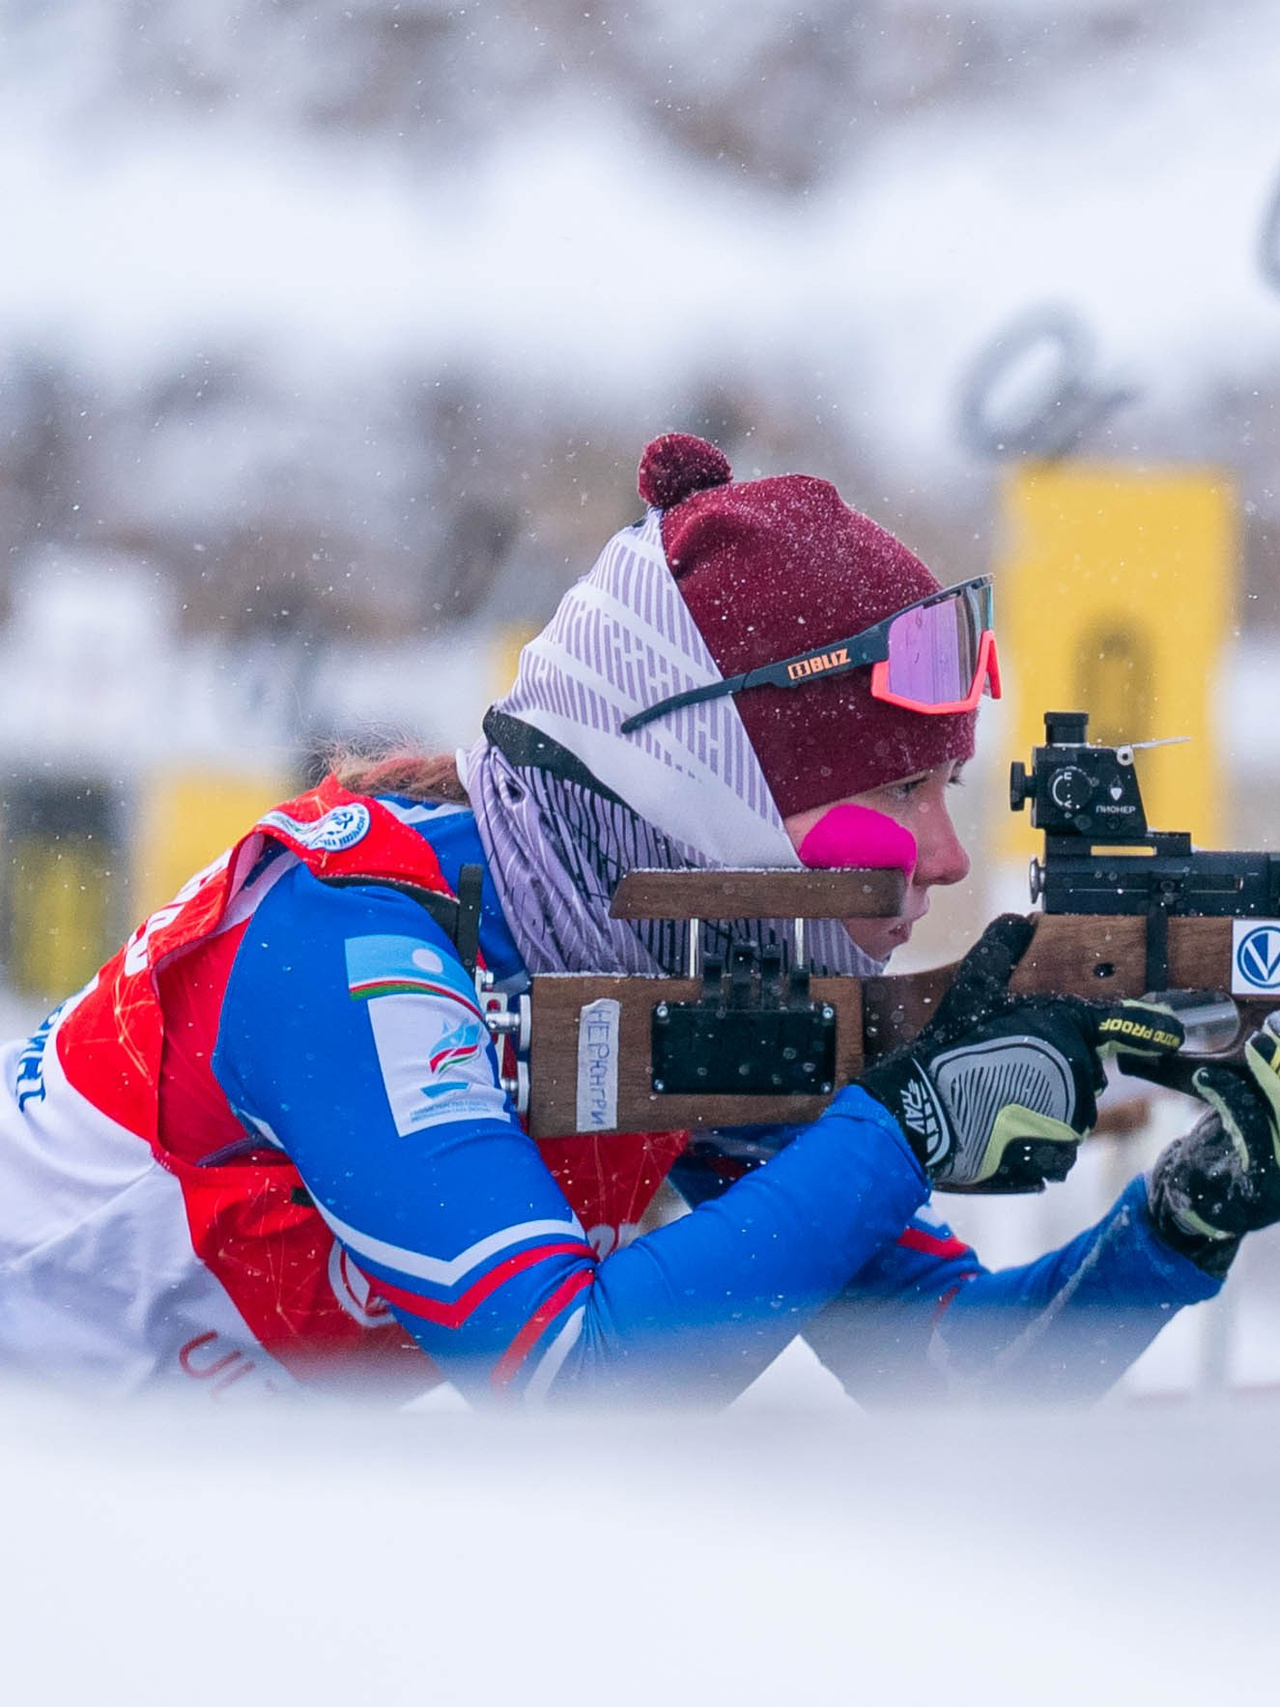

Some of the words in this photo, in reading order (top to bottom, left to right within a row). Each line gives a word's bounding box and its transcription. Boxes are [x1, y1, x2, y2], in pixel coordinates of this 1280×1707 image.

[808, 648, 852, 675] BLIZ
[1095, 805, 1136, 814] ПИОНЕР
[1098, 1017, 1154, 1040] PROOF
